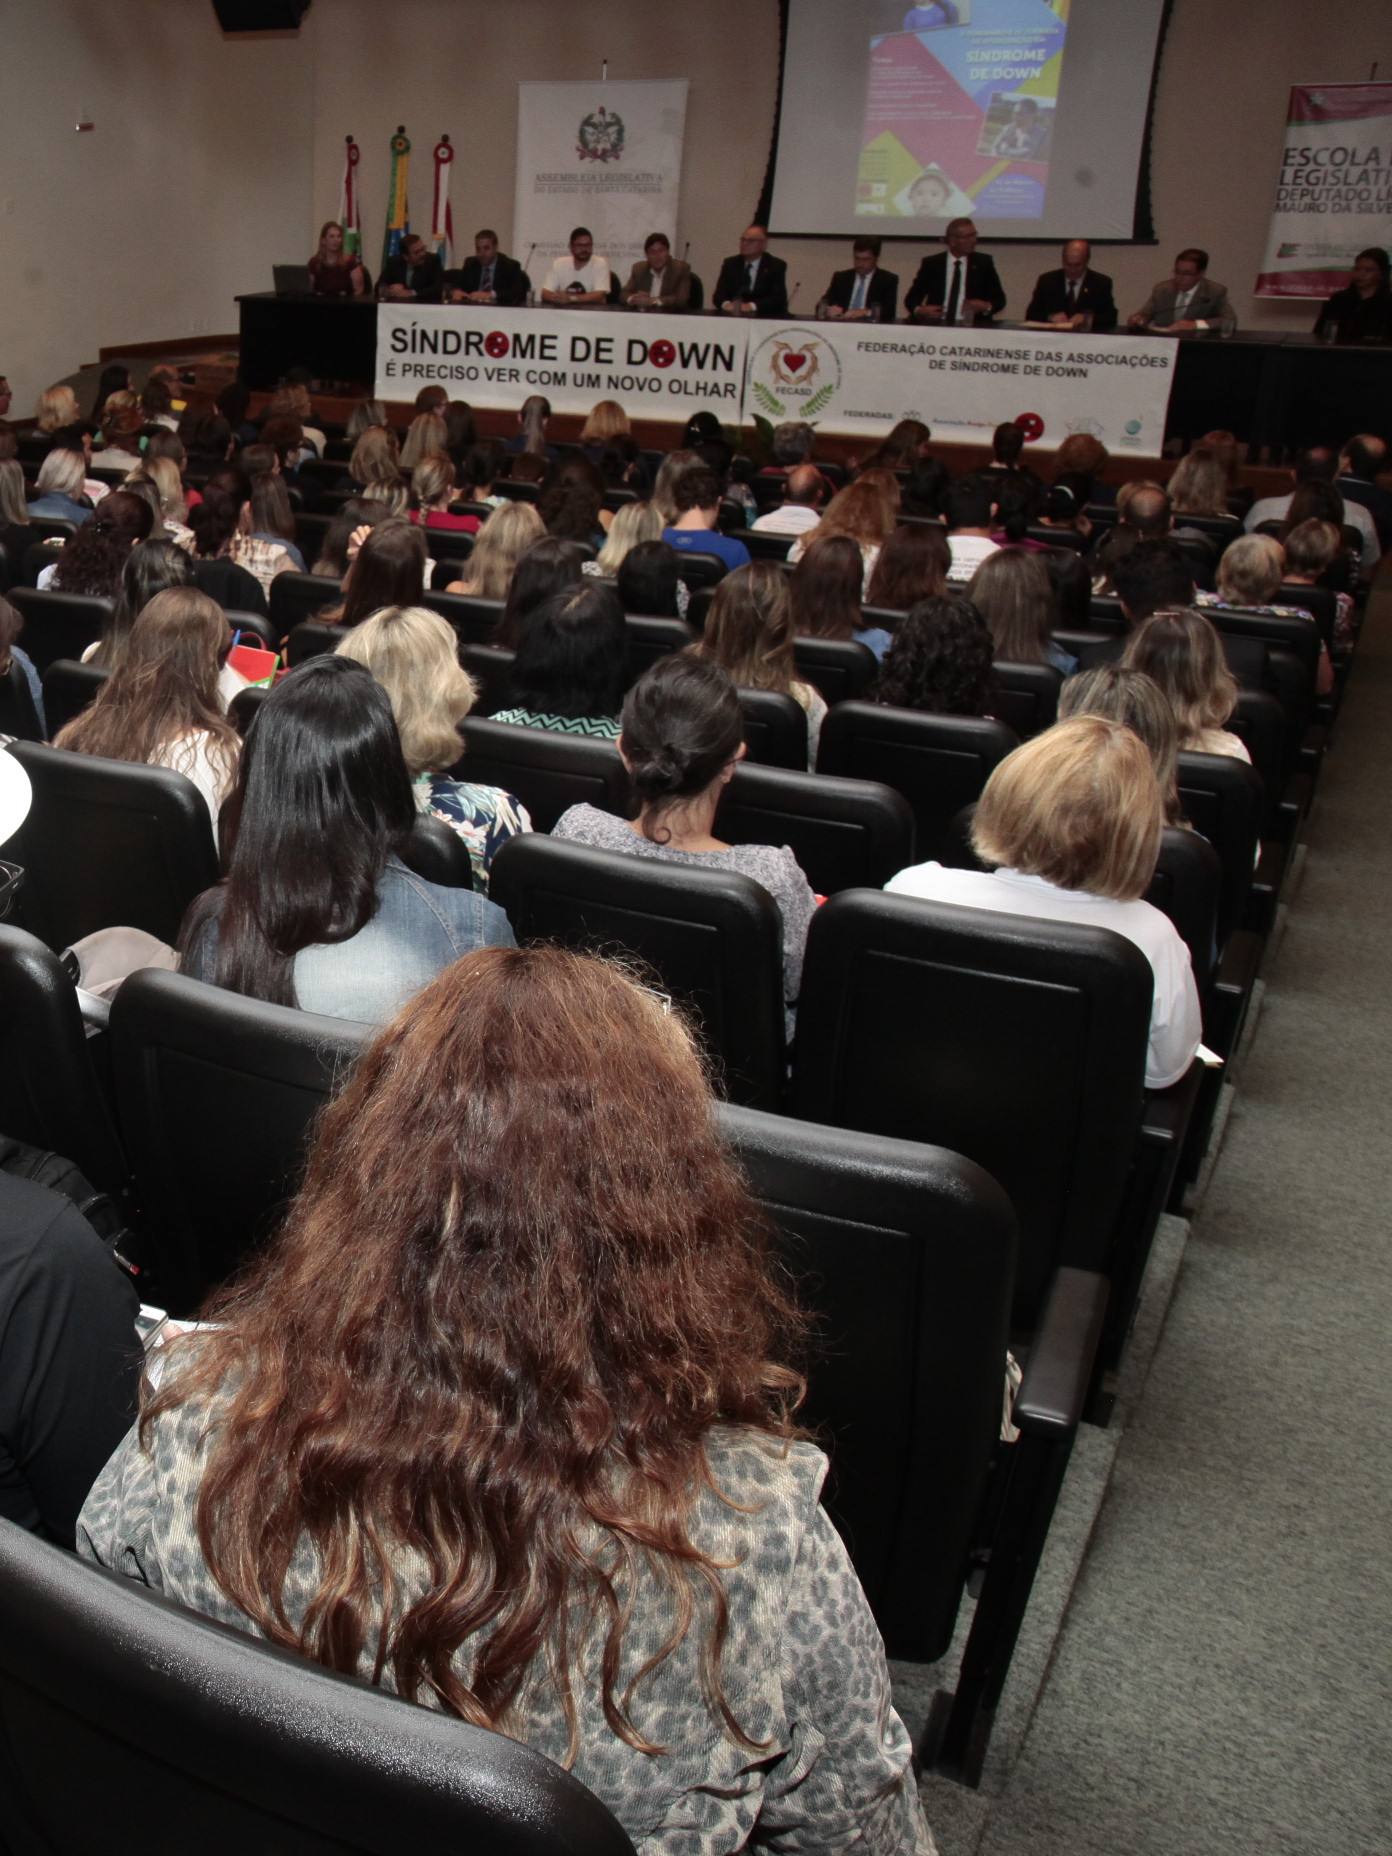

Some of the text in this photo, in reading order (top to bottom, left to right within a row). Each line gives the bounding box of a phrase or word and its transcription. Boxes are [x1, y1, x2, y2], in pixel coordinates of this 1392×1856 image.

[969, 66, 1043, 80] DE DOWN
[1283, 147, 1380, 167] ESCOLA
[1276, 188, 1372, 201] DEPUTADO
[1274, 202, 1328, 214] MAURO
[1331, 202, 1351, 213] DA
[569, 335, 614, 365] DE
[626, 338, 736, 372] DOWN
[856, 339, 1168, 369] FEDERAÇÃO CATARINENSE DAS ASSOCIAÇÕES
[385, 358, 737, 399] É PRECISO VER COM UM NOVO OLHAR
[929, 359, 1089, 379] DE SÍNDROME DE DOWN
